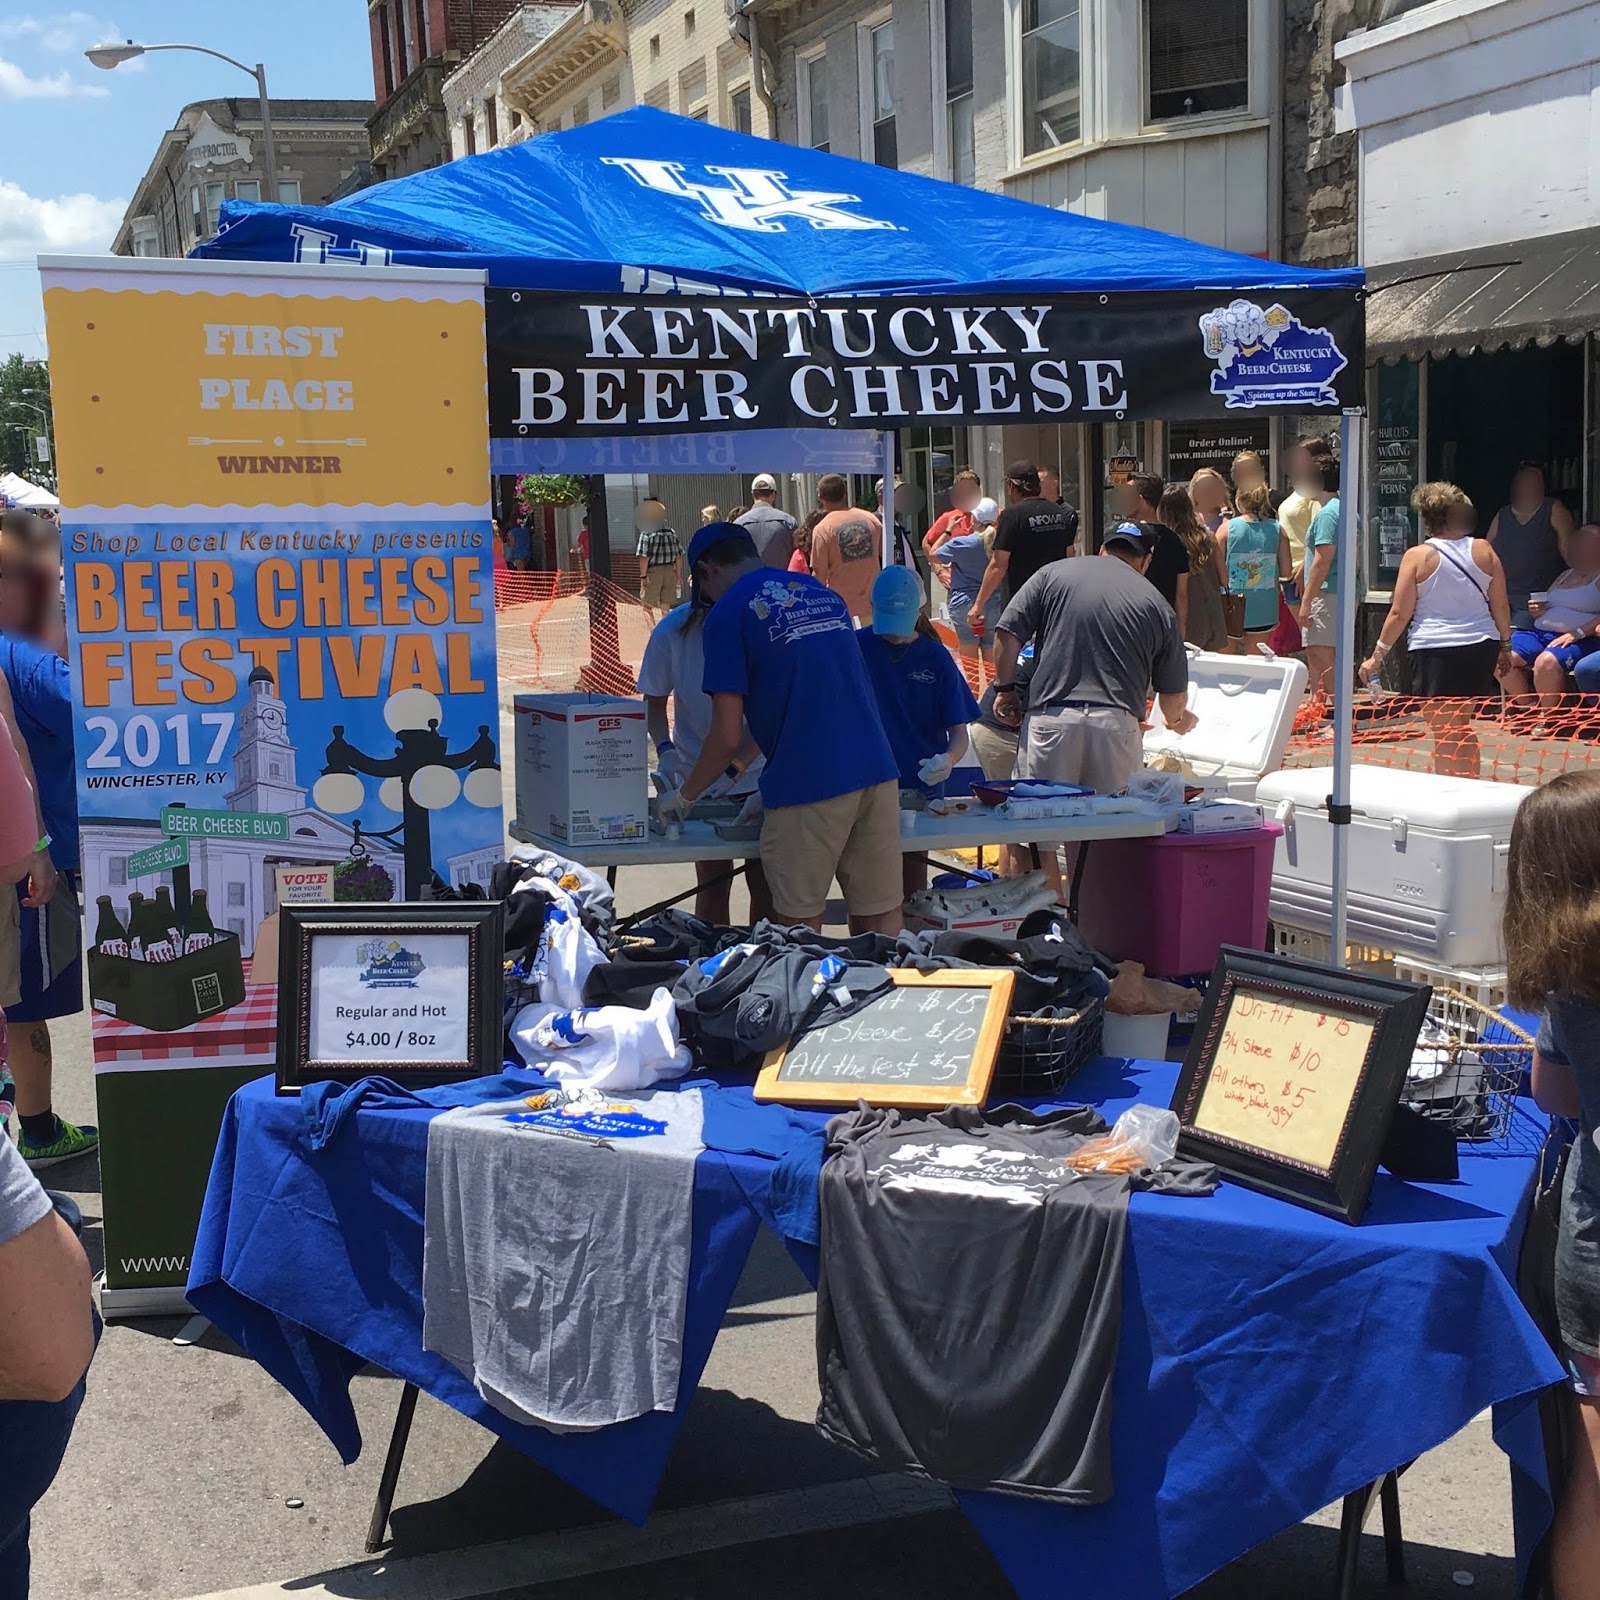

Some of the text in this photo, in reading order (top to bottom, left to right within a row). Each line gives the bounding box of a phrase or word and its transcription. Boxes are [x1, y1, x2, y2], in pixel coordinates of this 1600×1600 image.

[600, 156, 898, 233] UK
[203, 323, 345, 358] FIRST
[579, 304, 1053, 361] KENTUCKY
[1272, 346, 1332, 360] KENTUCKY
[200, 378, 355, 412] PLACE
[512, 359, 1129, 426] BEER CHEESE
[1247, 388, 1318, 400] Spicing up the State
[1188, 435, 1254, 448] Order Online!
[217, 455, 343, 475] WINNER
[1380, 483, 1408, 494] PERMS
[71, 528, 484, 556] Shop Local Kentucky presents
[73, 556, 485, 634] BEER CHEESE
[803, 597, 841, 607] KENTUCKY
[80, 631, 486, 708] FESTIVAL
[598, 718, 621, 728] GFS
[84, 711, 236, 770] 2017
[86, 771, 228, 791] WINCHESTER, KY
[168, 813, 282, 836] BEER CHEESE BLVD
[282, 873, 328, 886] VOTE
[289, 891, 322, 899] FAVORITE
[1002, 921, 1017, 929] GFS
[335, 1004, 447, 1020] Regular and Hot
[345, 1030, 436, 1049] $4.00 / 8oz
[831, 1020, 913, 1044] Sleeve
[1223, 1030, 1239, 1055] 3/4
[785, 1051, 832, 1078] All
[831, 1054, 867, 1080] the
[870, 1051, 920, 1080] rest
[1211, 1064, 1229, 1085] All
[121, 1256, 190, 1273] www.
